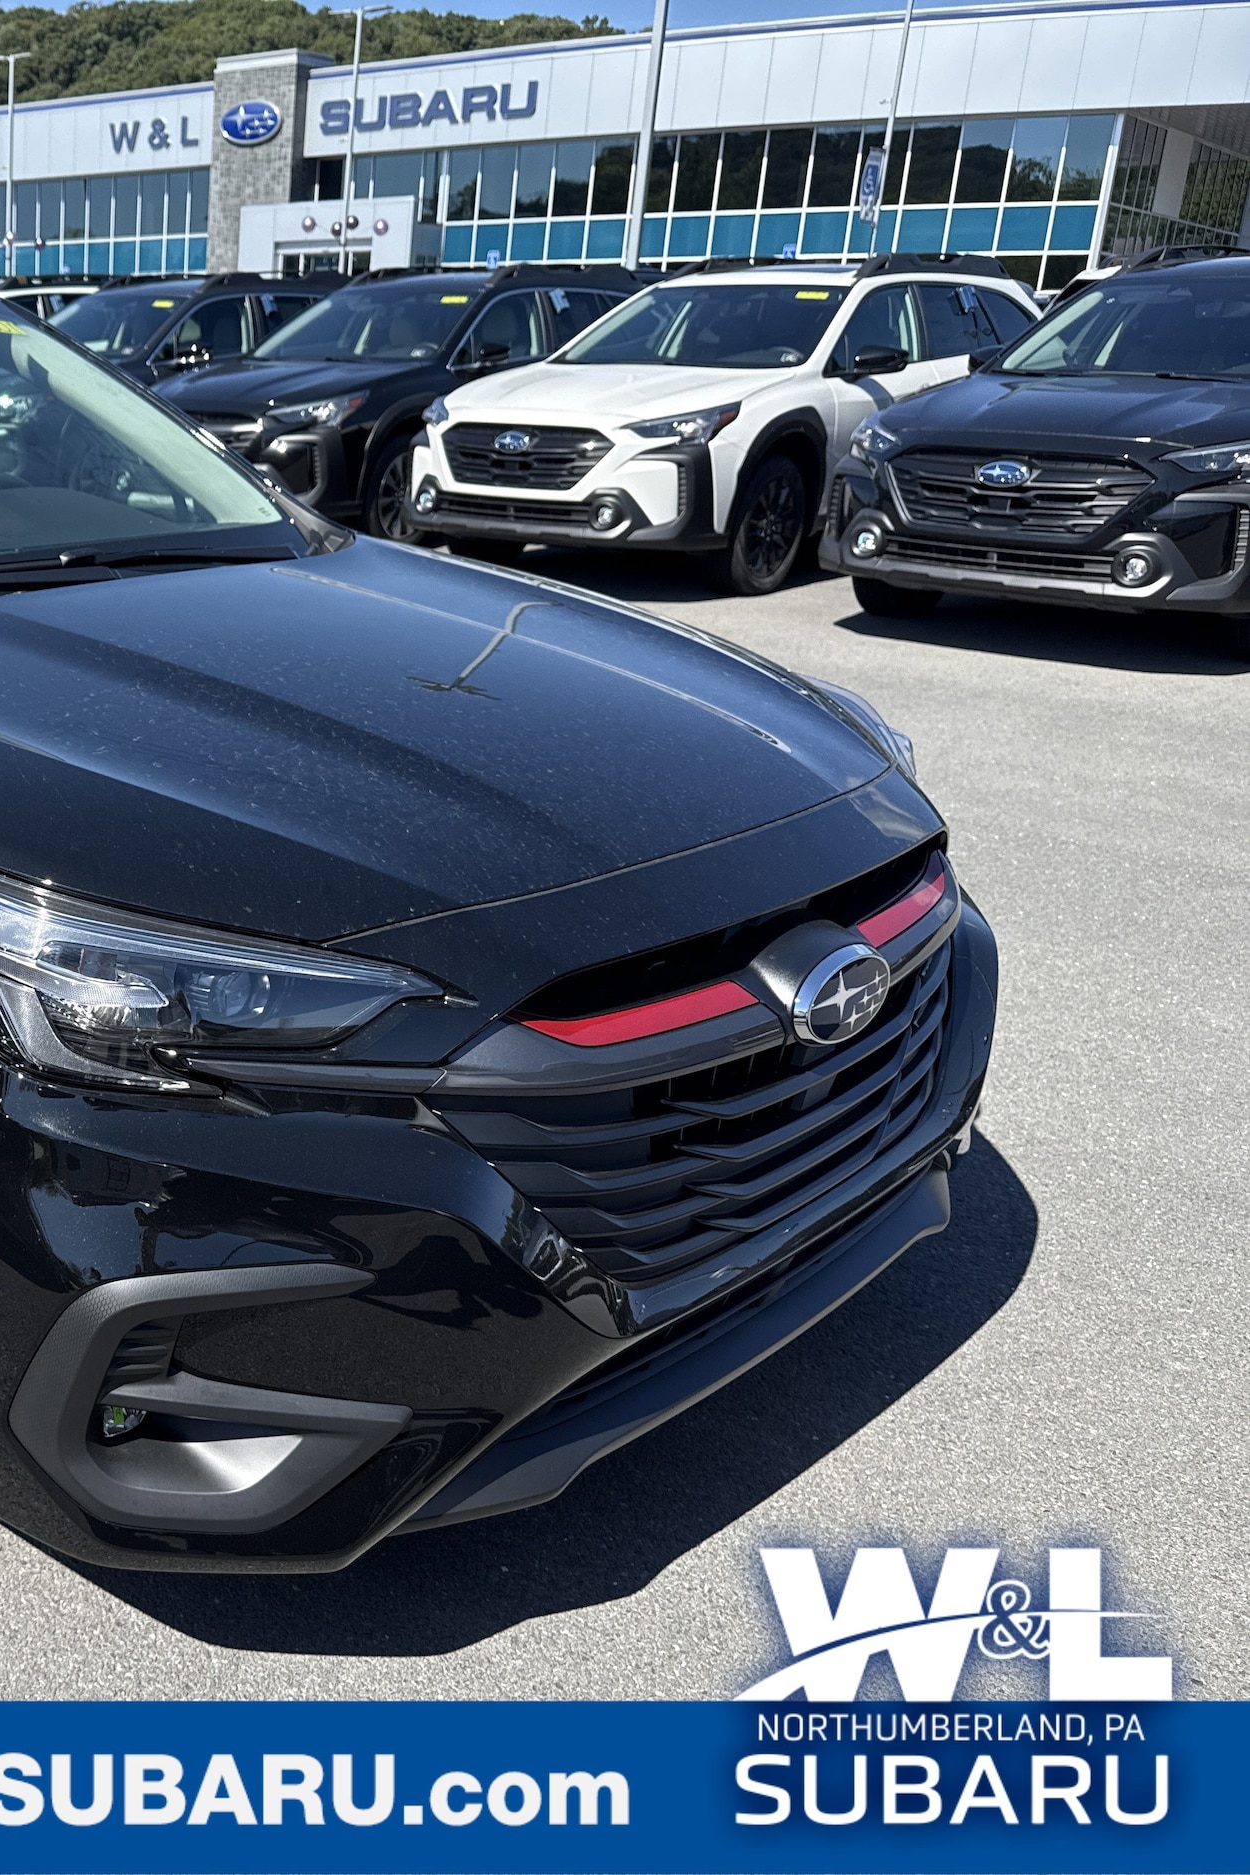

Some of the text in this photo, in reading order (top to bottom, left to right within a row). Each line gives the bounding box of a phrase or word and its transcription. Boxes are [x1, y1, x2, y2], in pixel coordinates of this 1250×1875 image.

[320, 80, 539, 136] SUBARU
[110, 115, 199, 154] W & L
